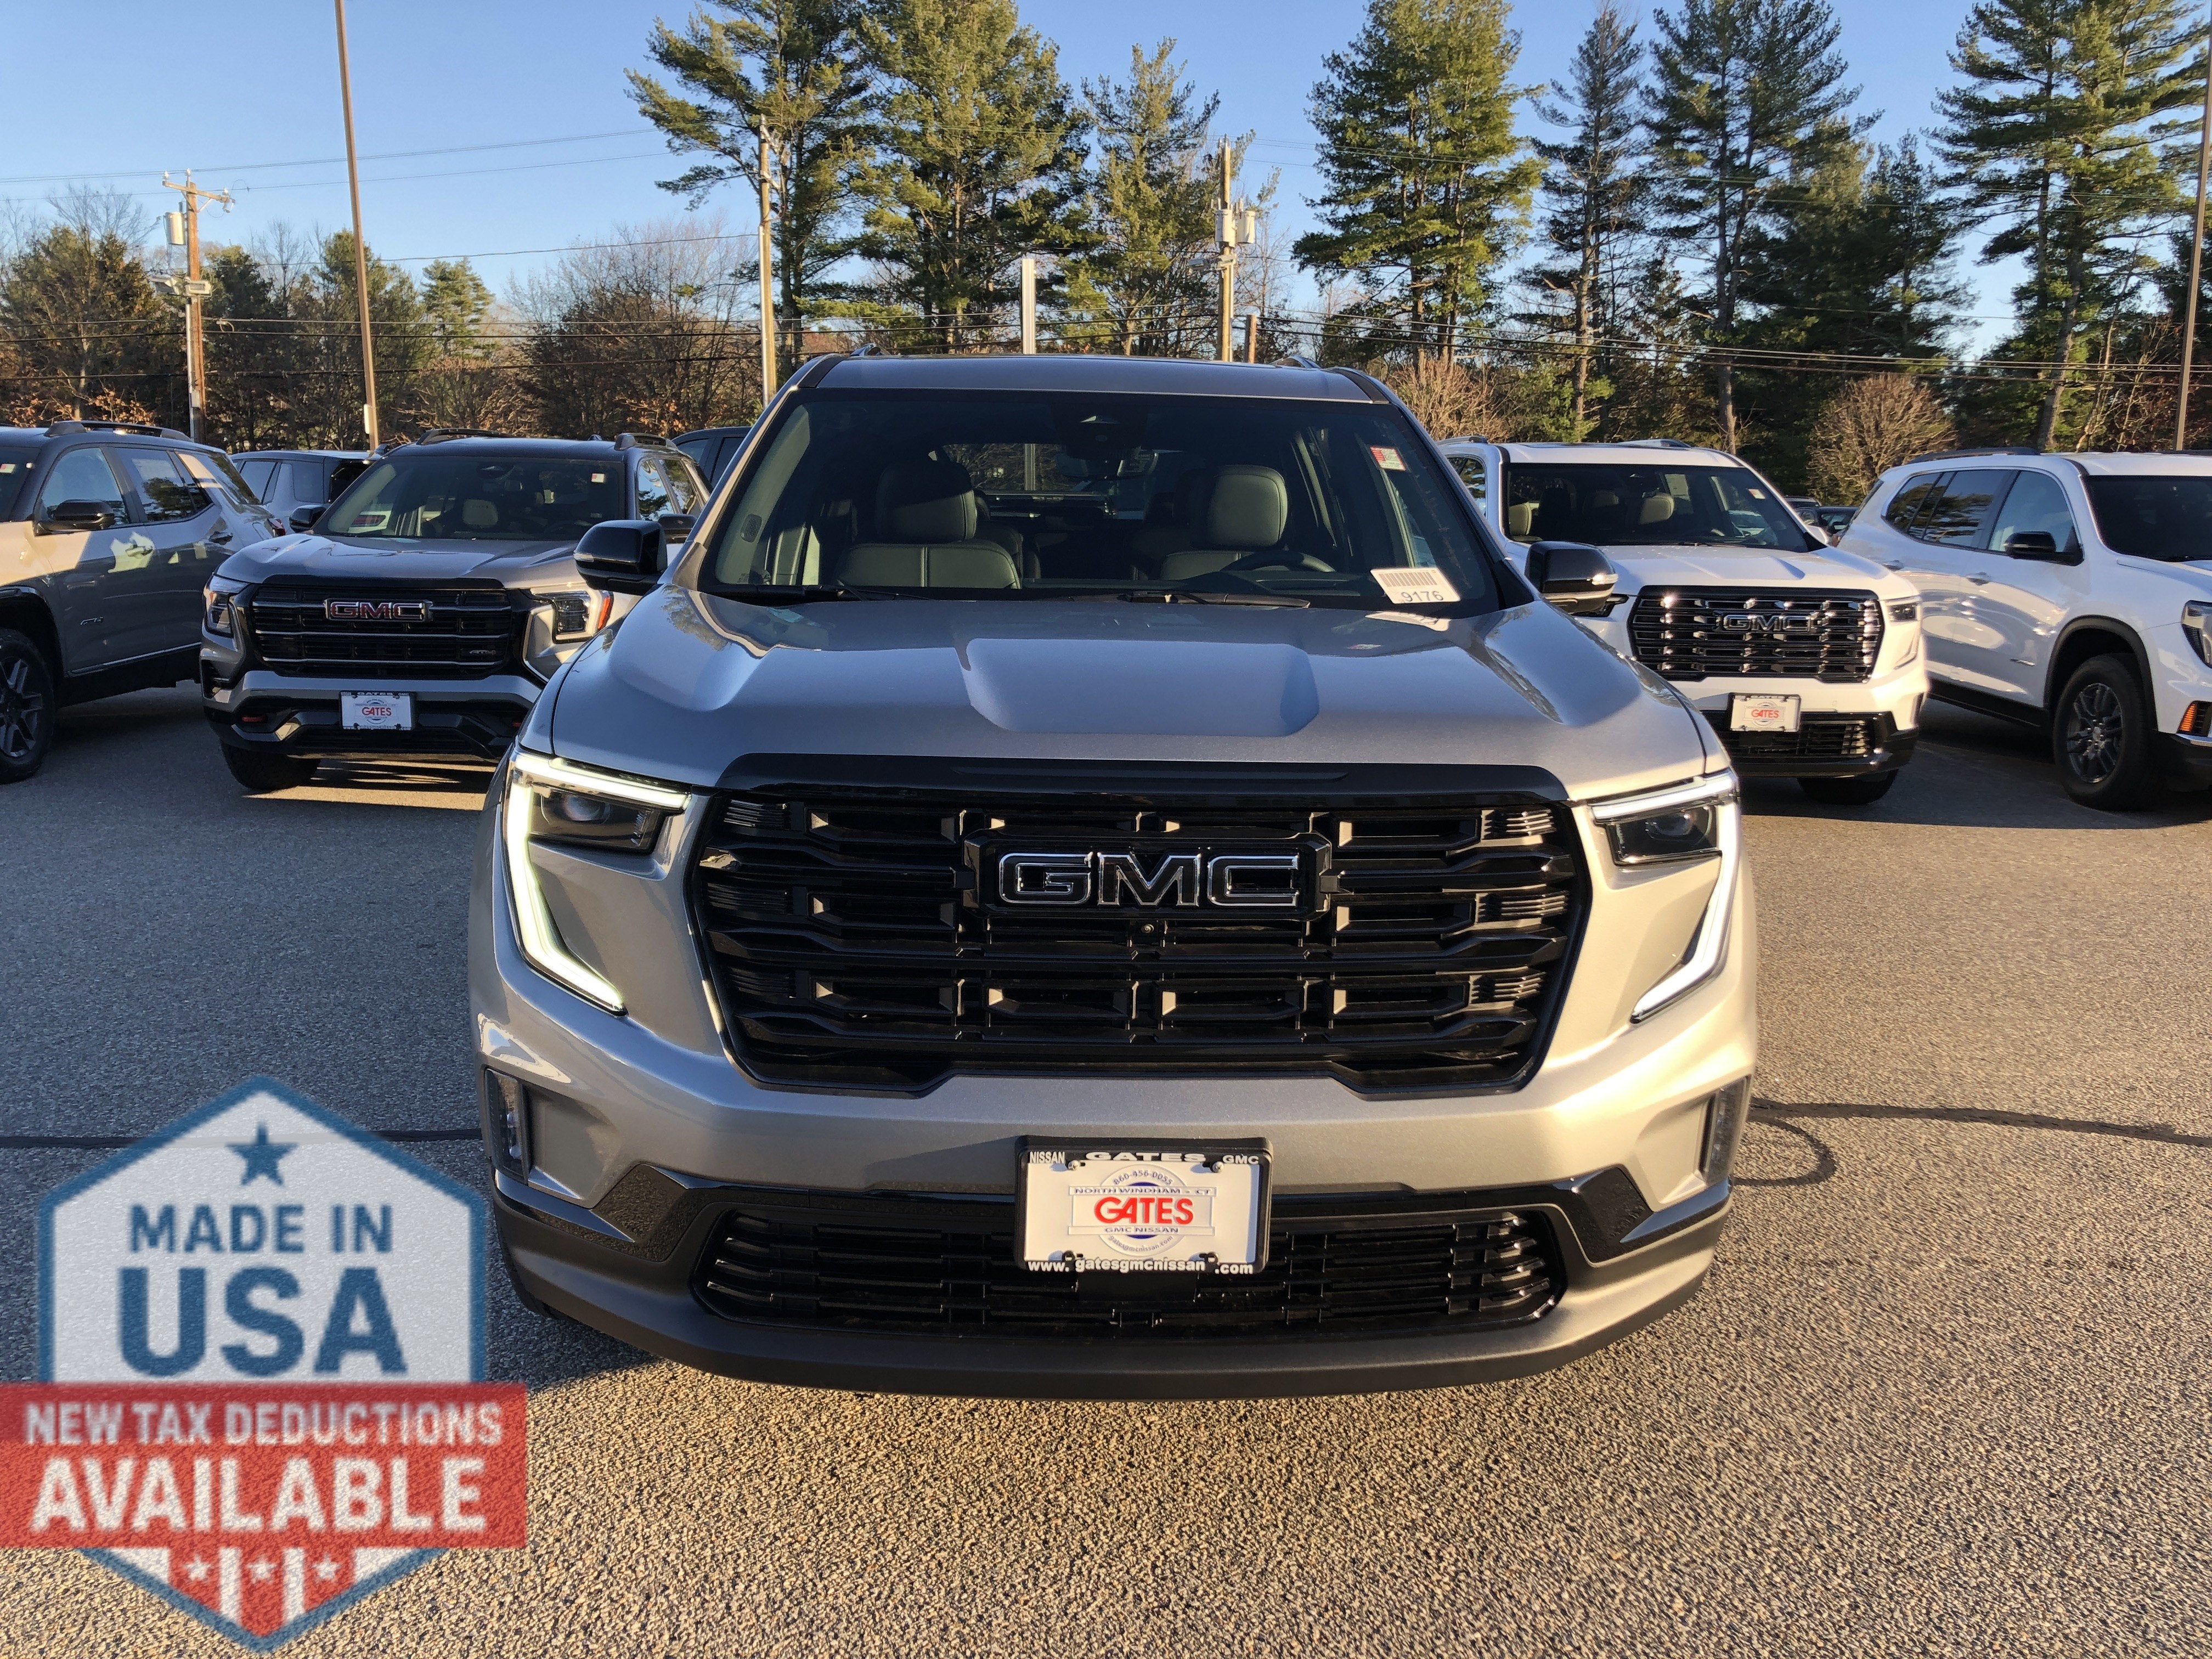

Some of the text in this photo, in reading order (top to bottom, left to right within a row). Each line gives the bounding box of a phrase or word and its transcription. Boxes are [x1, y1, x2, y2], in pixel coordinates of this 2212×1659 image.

[1401, 590, 1444, 602] 9176
[330, 601, 424, 620] GMC
[1723, 614, 1811, 631] GMC
[362, 707, 392, 716] GATES
[1751, 709, 1780, 718] GATES
[998, 851, 1300, 907] GMC
[1029, 1151, 1065, 1164] NISSAN
[1085, 1152, 1206, 1162] GATES
[1222, 1154, 1259, 1164] GMC
[1094, 1197, 1193, 1224] GATES
[1108, 1235, 1173, 1252] gatesgmcnissan.com
[1028, 1257, 1254, 1274] www. gatesgmcnissan .com
